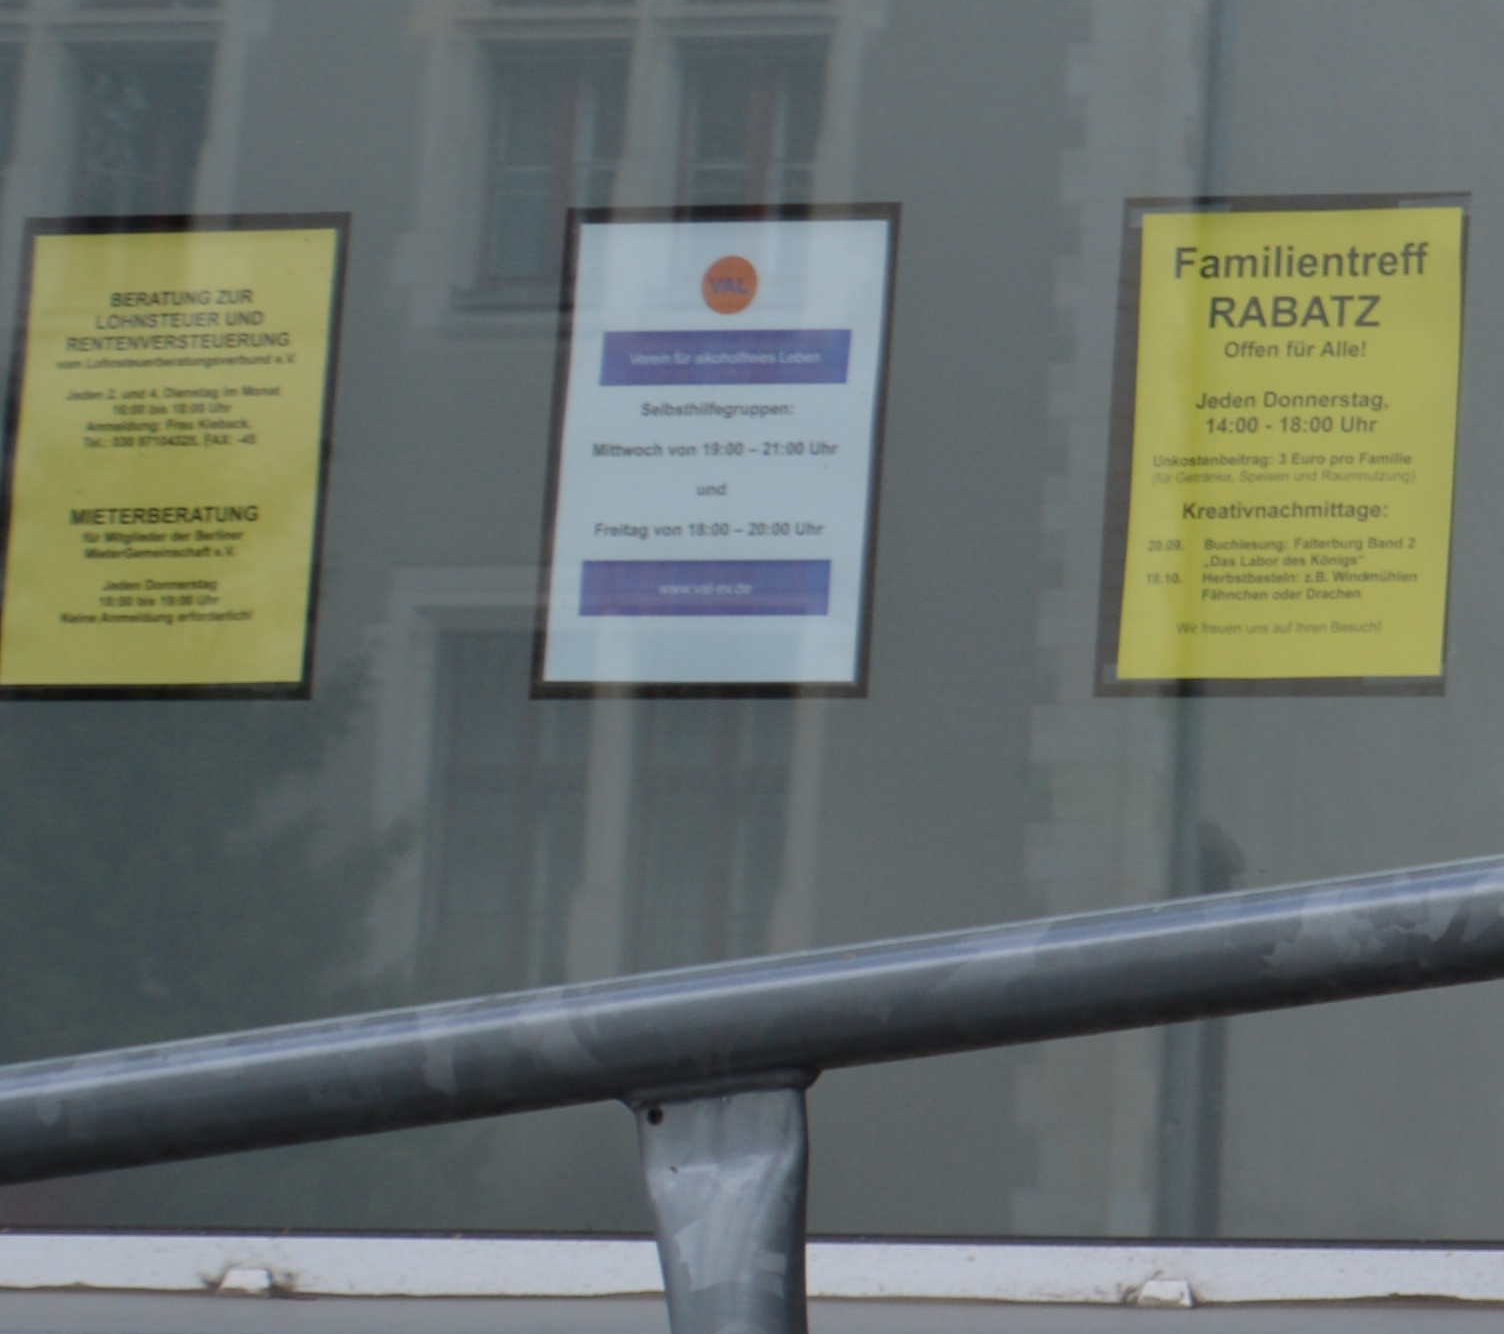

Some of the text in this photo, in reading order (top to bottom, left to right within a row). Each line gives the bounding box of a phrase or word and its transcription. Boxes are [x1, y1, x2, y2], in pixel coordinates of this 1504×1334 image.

[1173, 241, 1430, 279] Familientreff
[709, 276, 750, 295] VAL
[110, 288, 254, 308] BERATUNG ZUR
[95, 310, 264, 330] LOHNSTEUER UND
[1207, 295, 1382, 328] RABATZ
[66, 332, 290, 353] RENTENVERSTEUERUNG
[1223, 339, 1367, 359] Offen für Alle!
[1195, 391, 1256, 410] Jeden
[640, 402, 795, 419] Selbsthilfegruppen:
[1204, 417, 1259, 434] 14:00
[1279, 416, 1333, 433] 18:00
[1339, 415, 1377, 433] Uhr
[592, 442, 663, 457] Mittwoch
[667, 444, 698, 457] von
[808, 440, 839, 456] Uhr
[1152, 453, 1274, 470] Unkostenbeitrag:
[1291, 452, 1326, 465] Euro
[1330, 454, 1356, 468] pro
[1359, 451, 1413, 466] Familie
[696, 482, 728, 497] und
[69, 505, 259, 525] MIETERBERATUNG
[1181, 500, 1389, 523] Kreativnachmittage:
[594, 522, 649, 540] Freitag
[653, 525, 683, 538] von
[794, 521, 824, 536] Uhr
[1367, 537, 1404, 550] Band
[1240, 554, 1279, 567] Labor
[1282, 553, 1306, 567] des
[1306, 586, 1362, 601] Drachen
